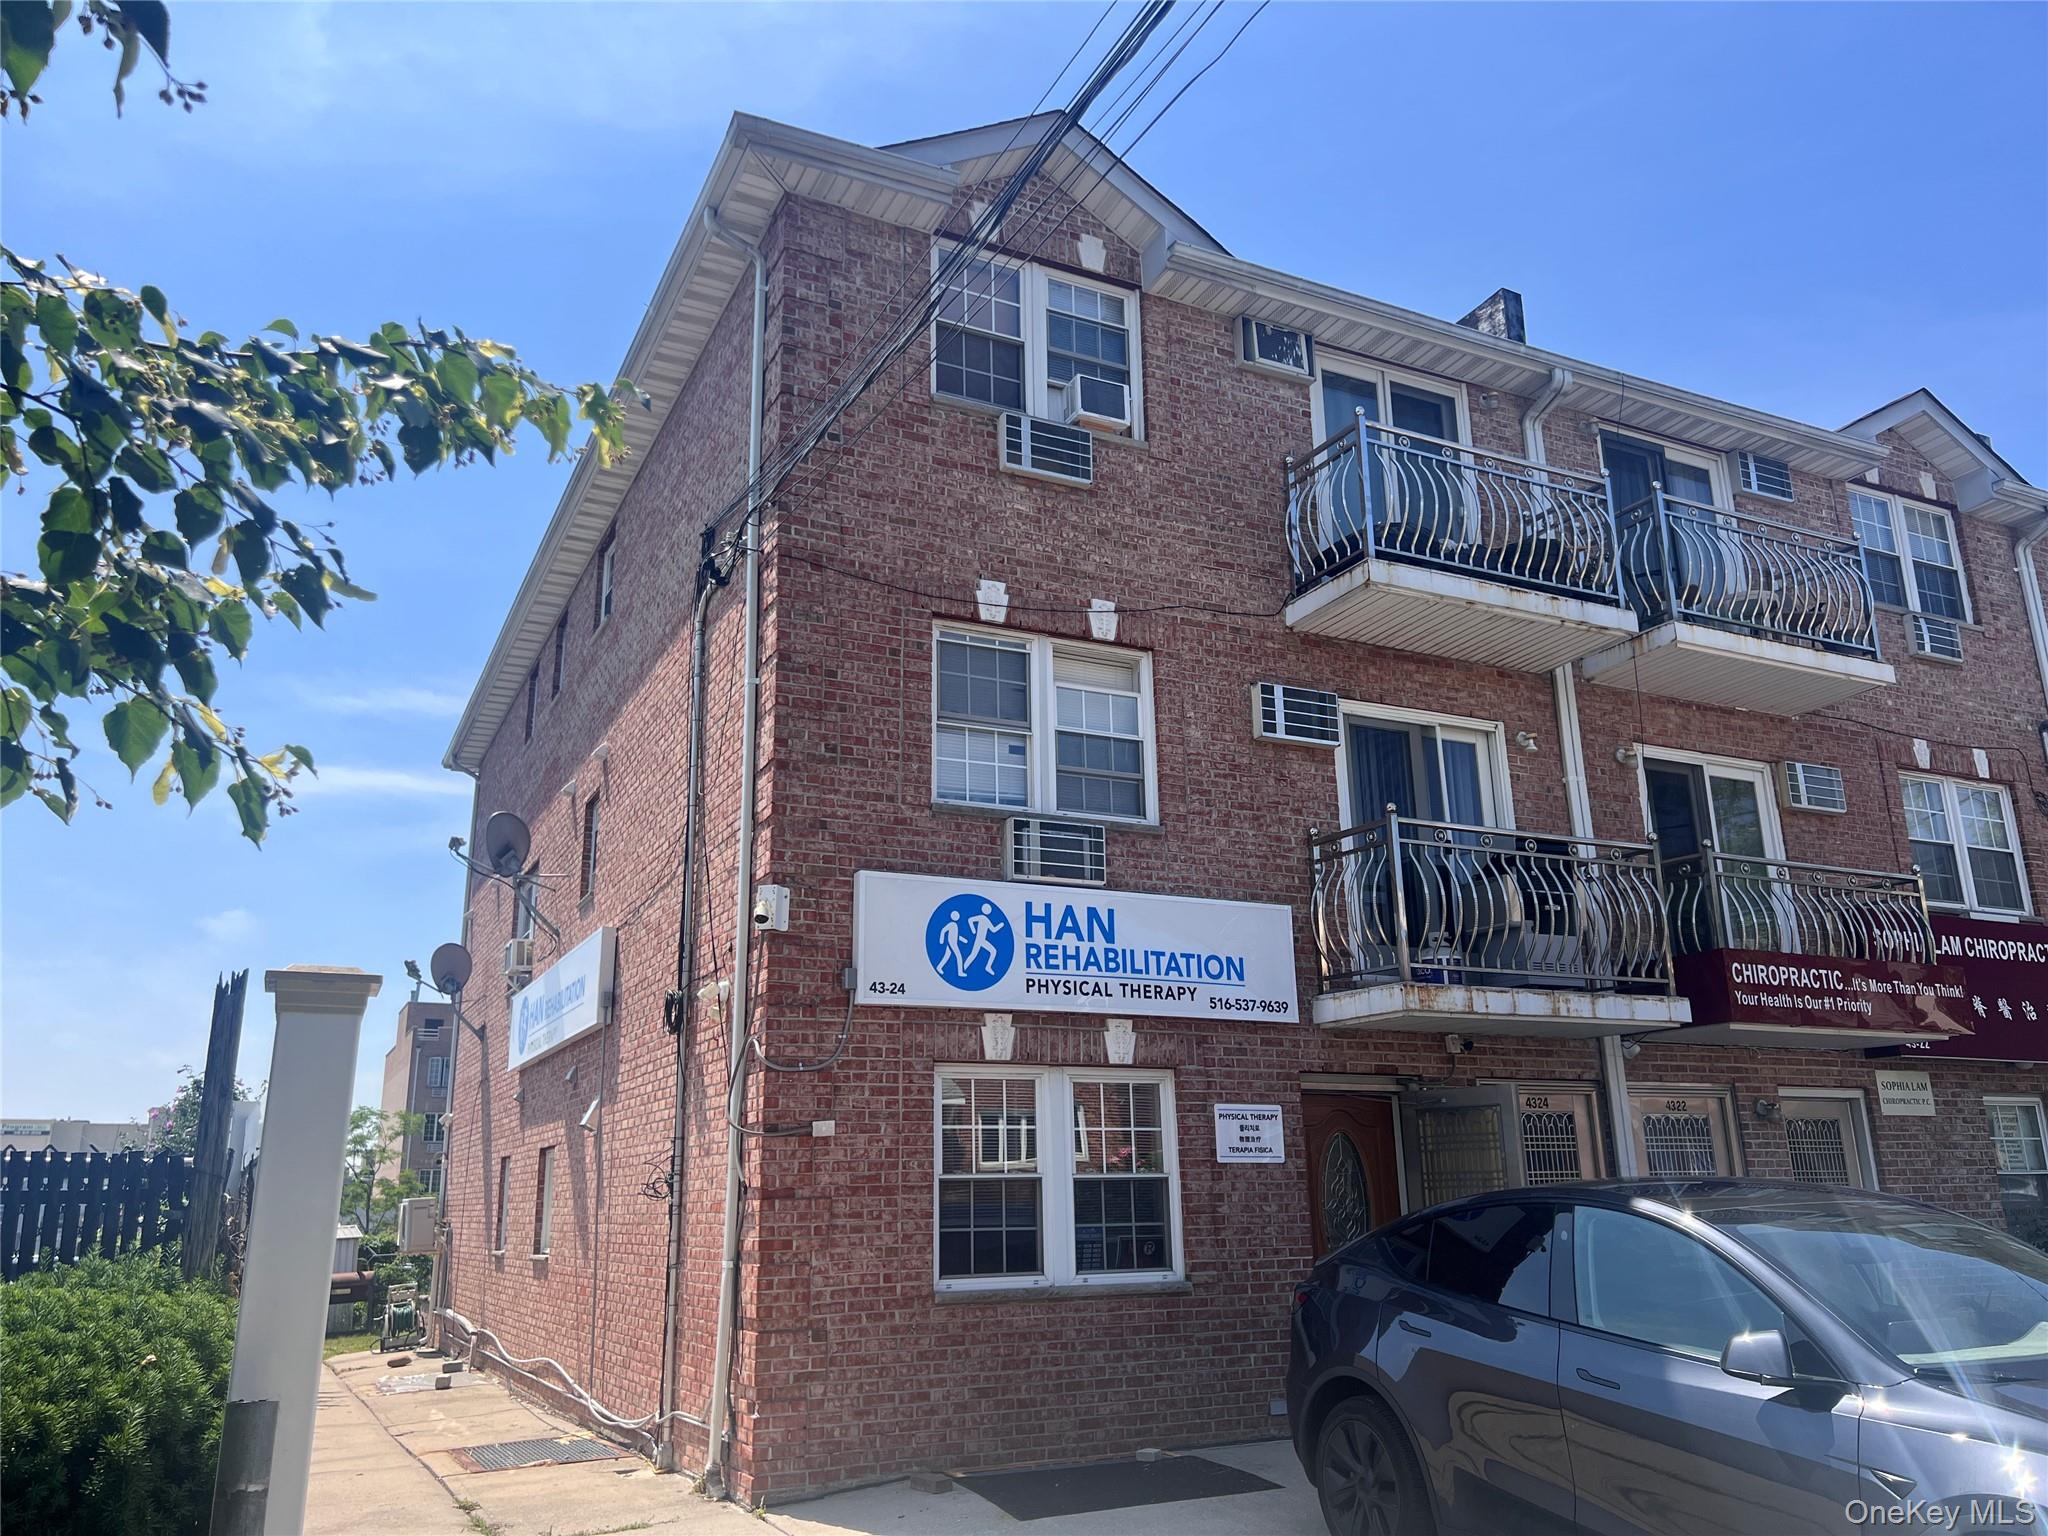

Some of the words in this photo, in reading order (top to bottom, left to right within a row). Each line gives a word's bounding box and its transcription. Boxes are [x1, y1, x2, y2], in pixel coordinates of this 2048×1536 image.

[1025, 901, 1116, 944] HAN
[1025, 943, 1245, 981] REHABILITATION
[869, 981, 906, 995] 43-24
[1025, 978, 1113, 998] PHYSICAL
[1119, 983, 1197, 1001] THERAPY
[1869, 979, 1892, 993] More
[1893, 980, 1917, 995] Than
[1917, 982, 1935, 996] You
[1935, 983, 1964, 998] Think!
[1209, 997, 1289, 1014] 516-537-9639
[1735, 990, 1758, 1006] Your
[1760, 992, 1793, 1008] Health
[1794, 994, 1803, 1009] Is
[1804, 995, 1823, 1010] Our
[1823, 996, 1836, 1011] #1
[1837, 997, 1872, 1016] Priority
[1881, 1081, 1911, 1091] SOPHIA
[1911, 1082, 1929, 1091] LAM
[1525, 1097, 1549, 1109] 4324
[1665, 1100, 1688, 1112] 4322
[1218, 1113, 1249, 1121] PHYSICAL
[1228, 1146, 1254, 1154] TERAPIA
